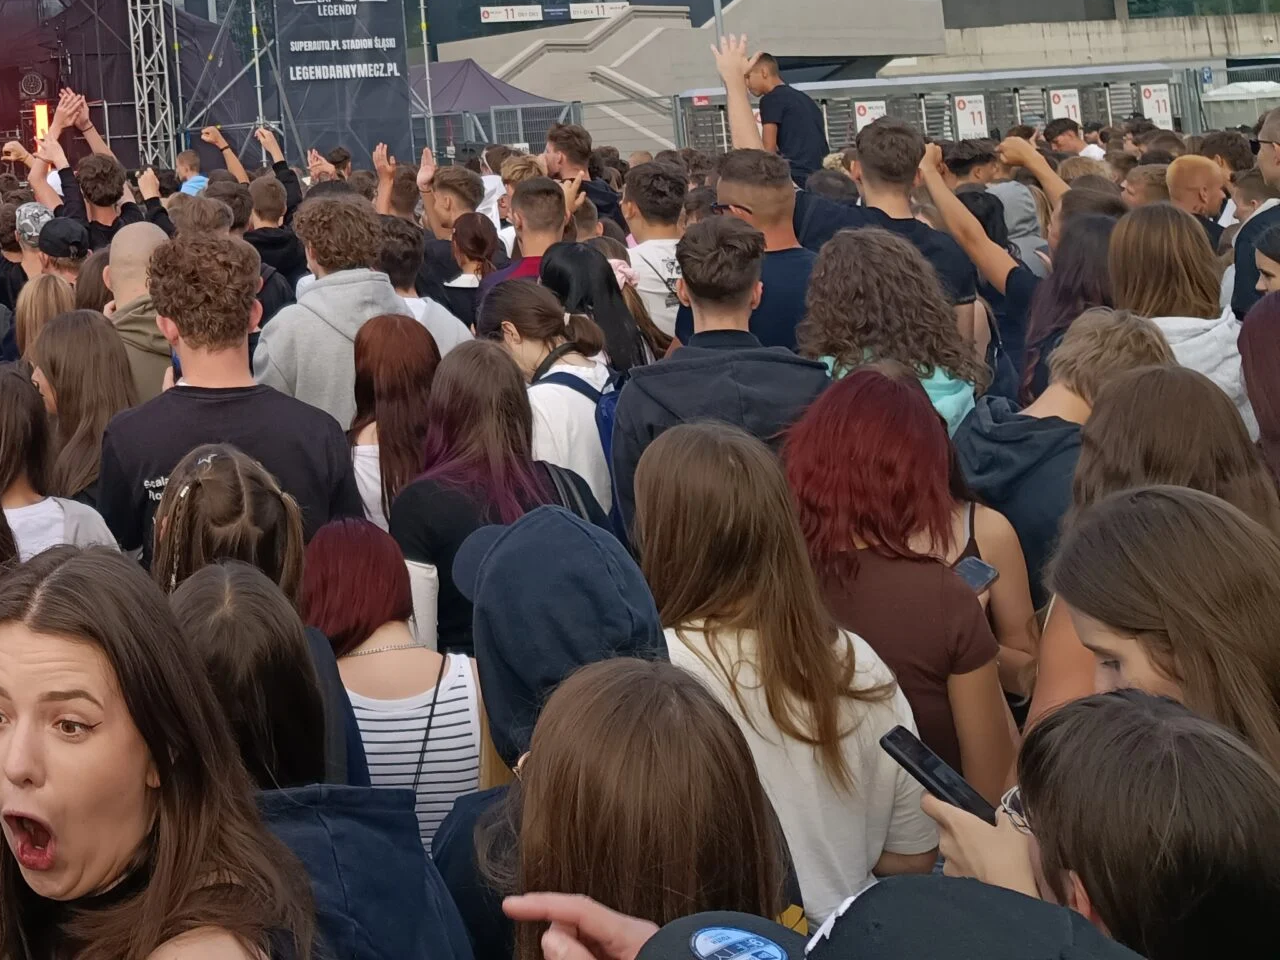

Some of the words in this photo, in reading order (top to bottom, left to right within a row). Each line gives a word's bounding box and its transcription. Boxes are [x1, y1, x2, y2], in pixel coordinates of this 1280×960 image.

[317, 4, 357, 16] LEGENDY
[290, 39, 340, 52] SUPERAUTO.PL
[342, 38, 372, 50] STADION
[290, 62, 400, 80] LEGENDARNYMECZ.PL
[1155, 99, 1168, 114] 11
[970, 111, 983, 126] 11
